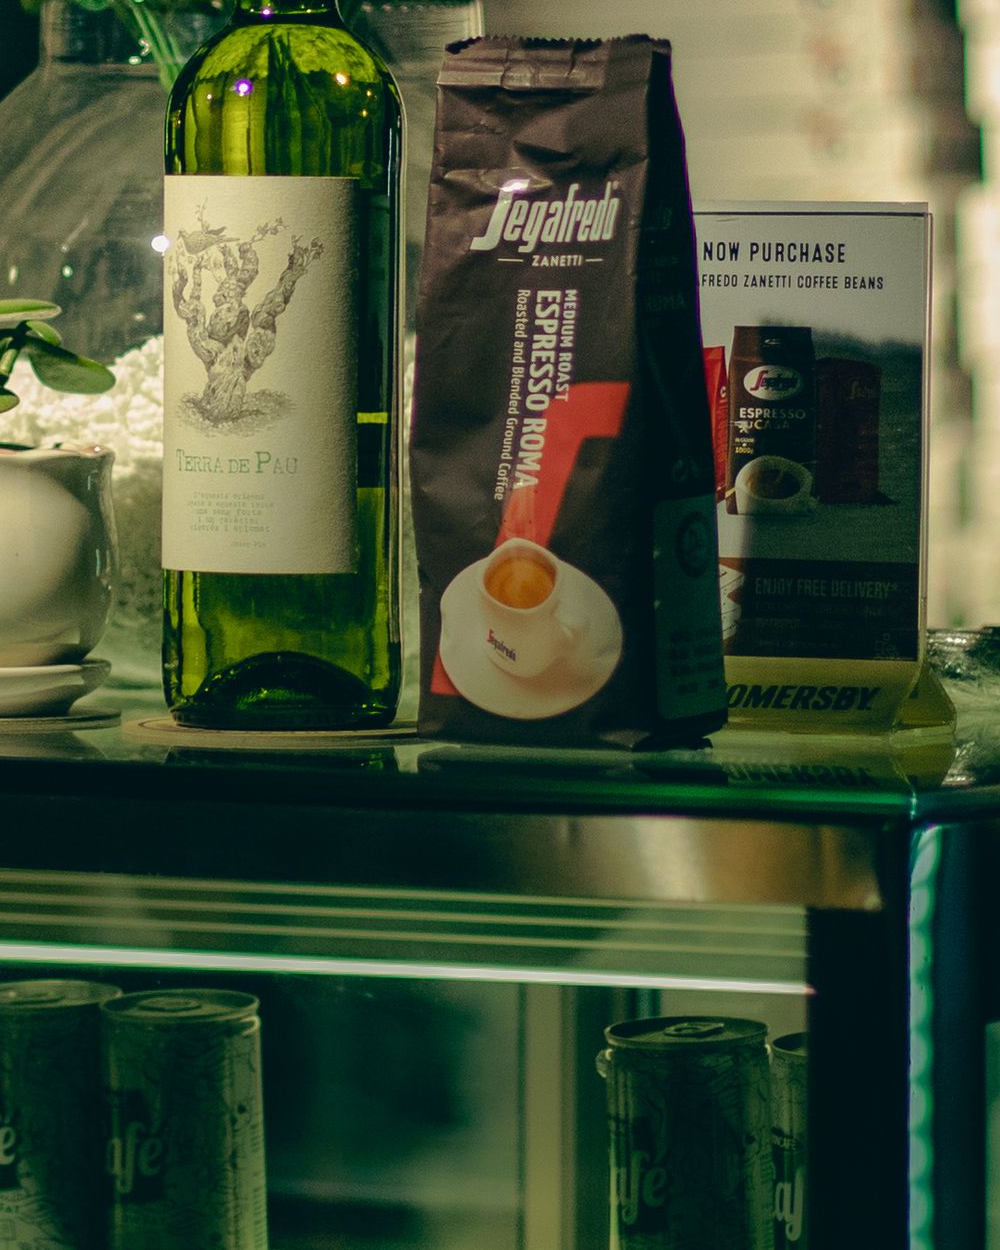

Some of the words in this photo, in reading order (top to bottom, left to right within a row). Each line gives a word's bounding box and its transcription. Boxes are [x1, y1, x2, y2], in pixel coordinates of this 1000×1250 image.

[470, 180, 620, 253] Segafredo
[531, 254, 583, 267] ZANETTI
[703, 241, 740, 262] NOW
[750, 242, 846, 263] PURCHASE
[701, 274, 738, 288] FREDO
[744, 275, 792, 288] ZANETTI
[797, 275, 839, 289] COFFEE
[844, 276, 884, 290] BEANS
[514, 289, 532, 338] Roasted
[560, 289, 578, 347] MEDIUM
[512, 340, 527, 363] and
[525, 289, 562, 411] ESPRESSO
[507, 366, 525, 415] Blended
[554, 352, 573, 403] ROAST
[739, 407, 807, 420] ESPRESSO
[500, 417, 518, 460] Ground
[513, 417, 548, 491] ROMA
[493, 462, 512, 501] Coffee
[755, 577, 792, 596] ENJOY
[796, 578, 827, 597] FREE
[727, 683, 882, 711] OMERSBY.
